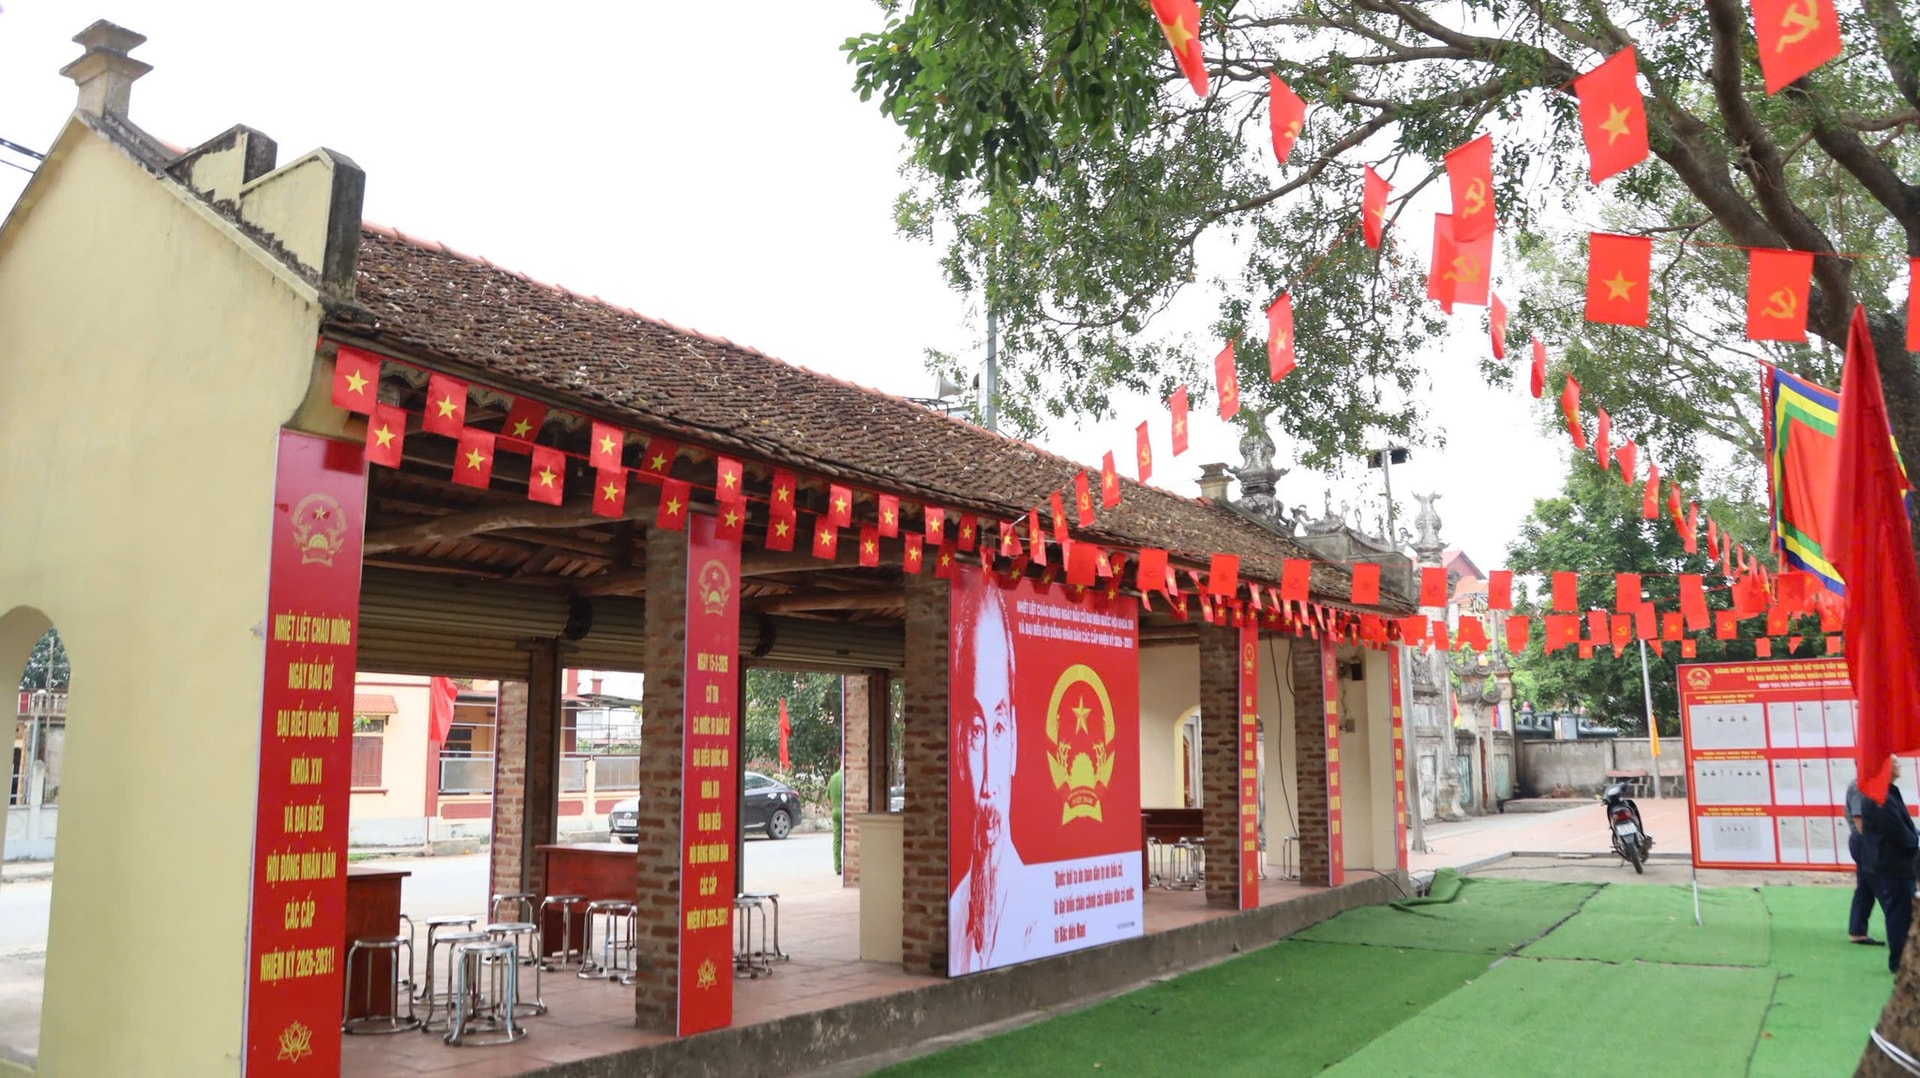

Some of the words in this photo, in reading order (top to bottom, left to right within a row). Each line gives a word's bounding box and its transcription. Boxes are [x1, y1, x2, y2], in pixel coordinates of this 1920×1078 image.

[274, 609, 295, 647] NHIỆT
[296, 610, 310, 648] LIỆT
[311, 611, 330, 644] CHÀO
[330, 613, 351, 645] MỪNG
[288, 657, 308, 690] NGÀY
[308, 655, 323, 690] BẦU
[323, 656, 334, 690] CỬ
[277, 709, 290, 743] ĐẠI
[290, 698, 308, 737] BIỂU
[307, 702, 327, 741] QUỐC
[327, 706, 339, 743] HỘI
[290, 752, 310, 784] KHÓA
[310, 758, 322, 784] XVI
[284, 800, 293, 832] VÀ
[294, 805, 307, 839] ĐẠI
[308, 794, 324, 832] BIỂU
[266, 849, 280, 889] HỘI
[279, 844, 300, 882] ĐỒNG
[300, 847, 321, 880] NHÂN
[321, 846, 336, 879] DÂN
[285, 896, 300, 930] CÁC
[300, 891, 315, 928] CẤP
[260, 947, 284, 987] NHIỆM
[285, 945, 296, 979] KỲ
[296, 946, 334, 978] 2026-2031!
